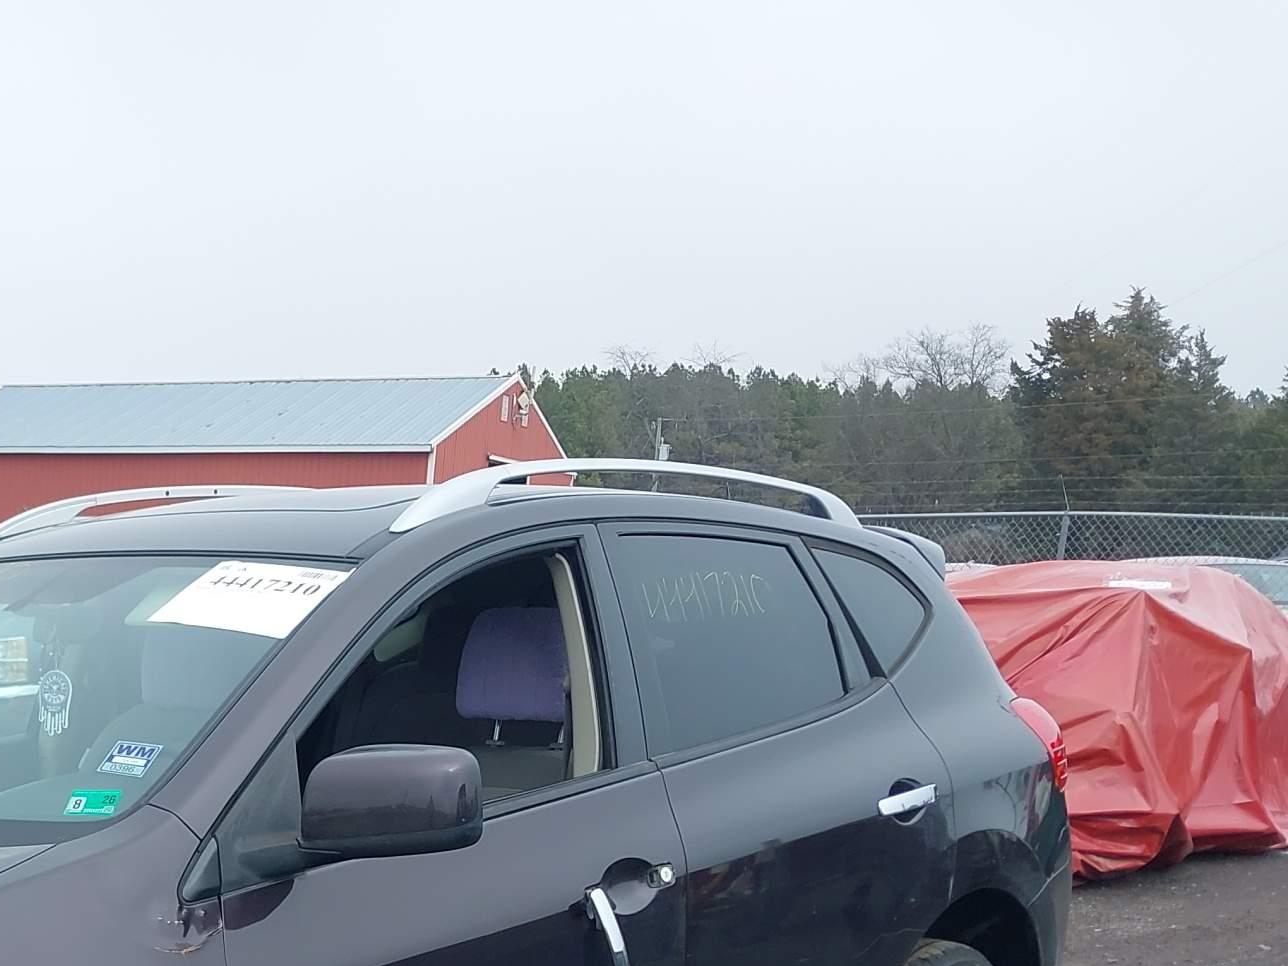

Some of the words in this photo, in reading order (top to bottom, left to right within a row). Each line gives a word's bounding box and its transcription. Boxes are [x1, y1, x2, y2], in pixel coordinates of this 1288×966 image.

[210, 576, 321, 595] 44417210
[117, 744, 155, 759] WM
[73, 799, 82, 809] 8
